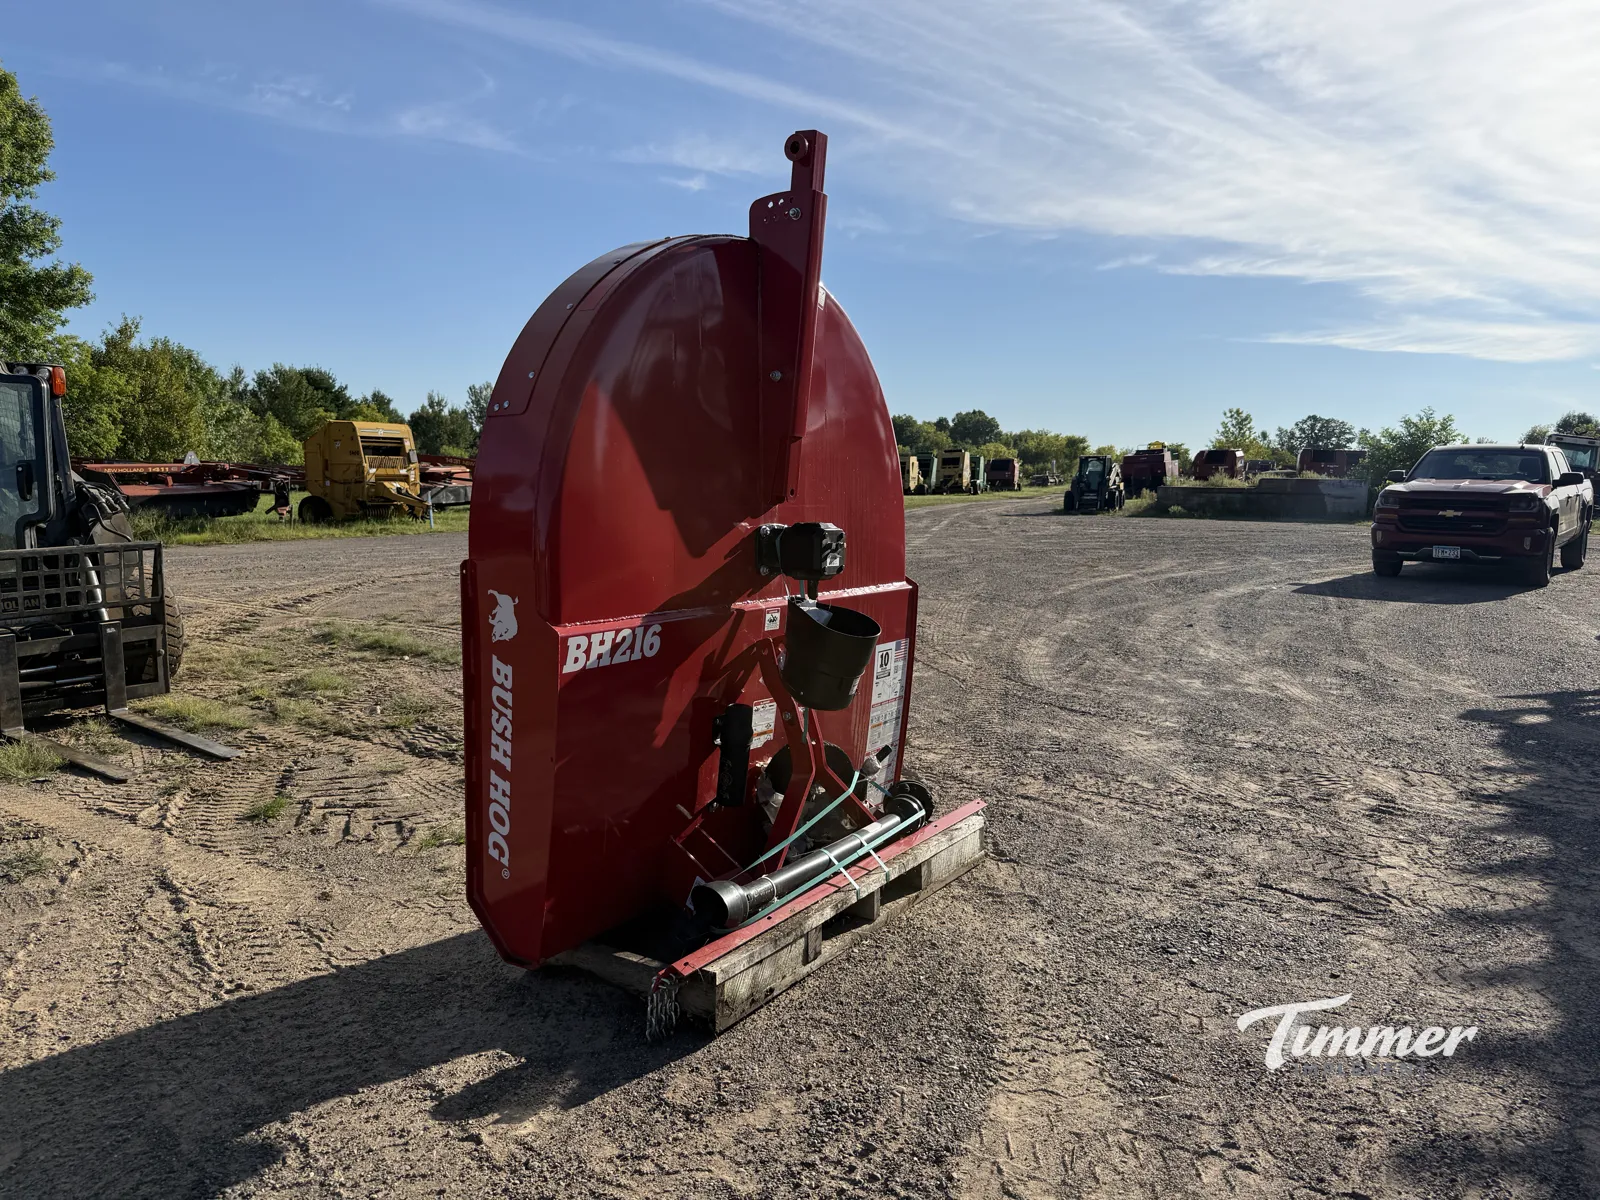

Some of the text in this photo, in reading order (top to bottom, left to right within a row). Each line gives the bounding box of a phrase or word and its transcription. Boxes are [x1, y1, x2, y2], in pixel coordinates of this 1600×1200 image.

[562, 624, 662, 674] BH216
[879, 651, 890, 669] 10
[491, 654, 513, 773] BUSH
